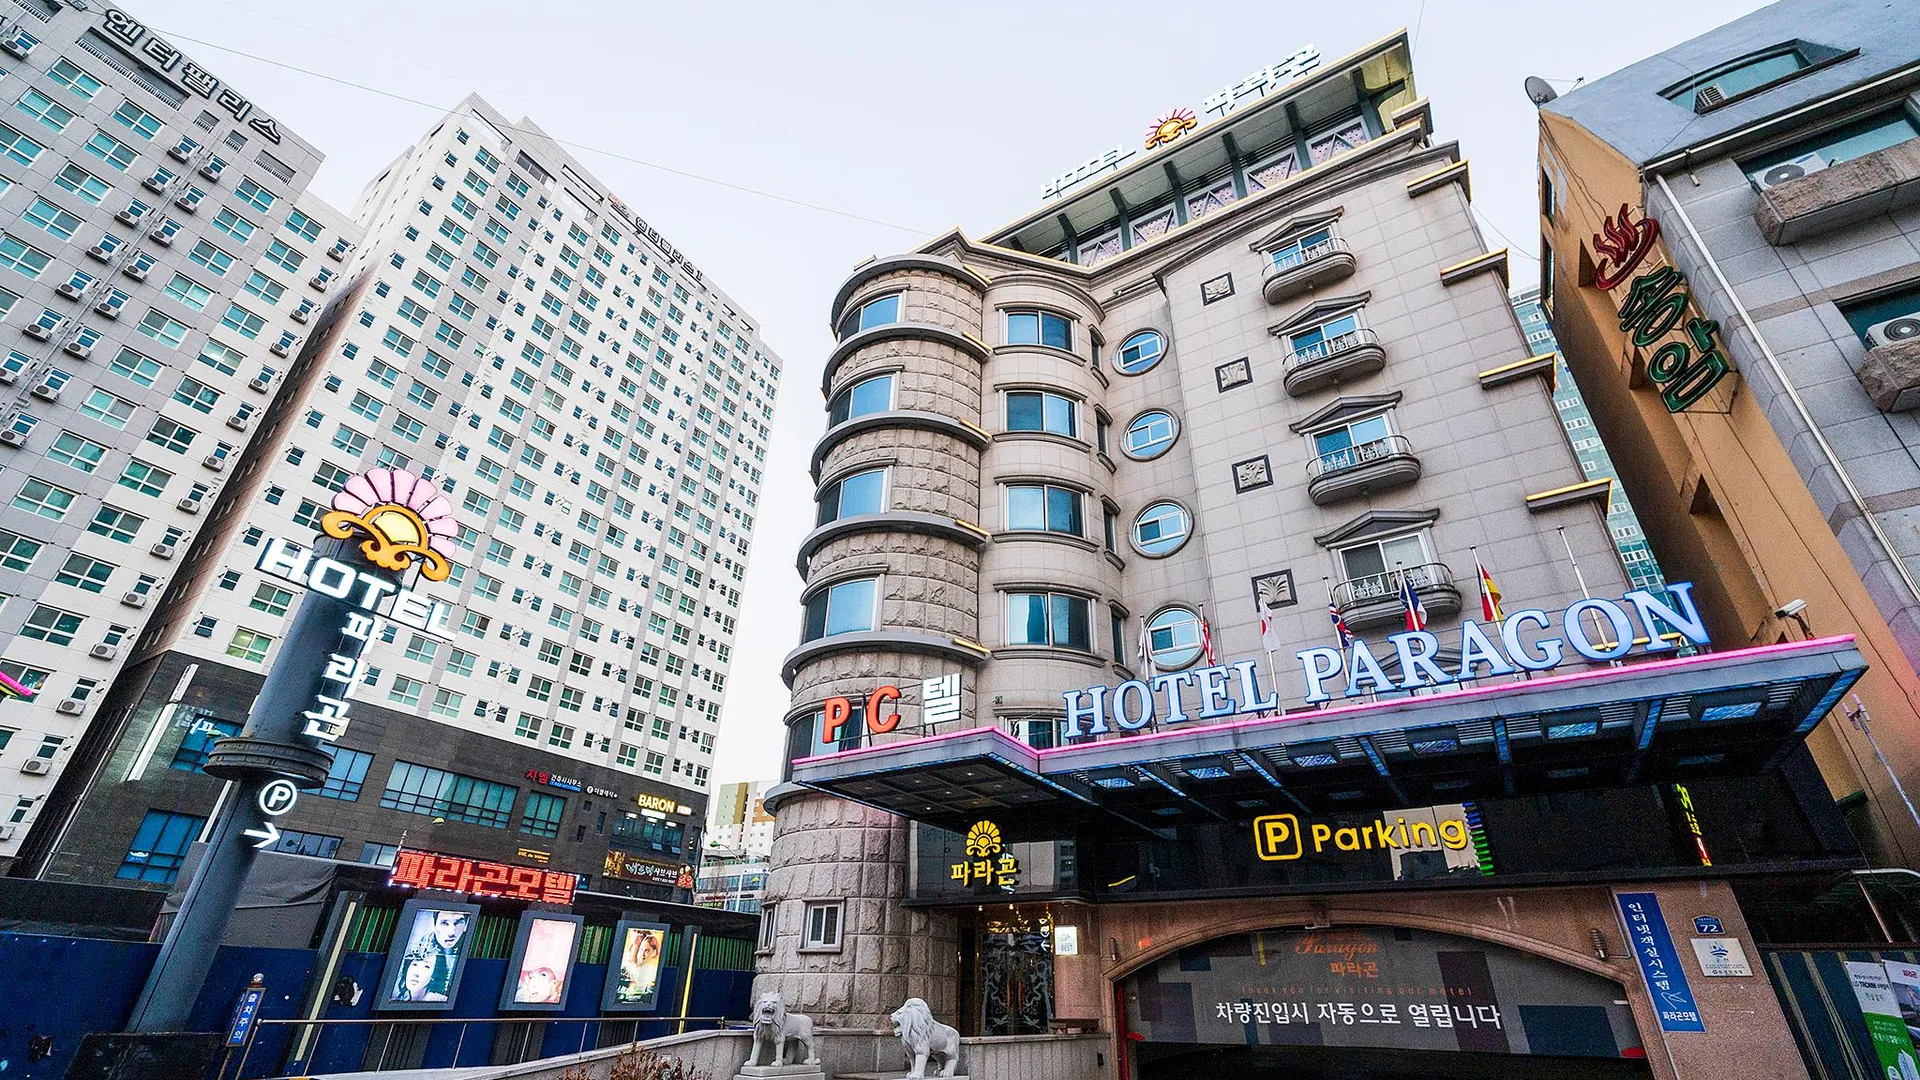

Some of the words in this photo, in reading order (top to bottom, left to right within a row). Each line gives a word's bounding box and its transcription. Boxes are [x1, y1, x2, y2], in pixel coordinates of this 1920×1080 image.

[1203, 43, 1321, 113] 파라곤
[1040, 143, 1136, 199] HOTEL
[256, 537, 457, 641] HOTEL
[301, 612, 386, 741] 파라곤
[1062, 659, 1279, 739] HOTEL
[1296, 581, 1711, 704] PARAGON
[638, 793, 676, 813] BARON
[1310, 816, 1469, 853] Parking
[393, 851, 575, 904] 파라곤모텔
[950, 859, 1017, 887] 파라곤
[1700, 924, 1719, 932] 72
[1330, 961, 1379, 978] 파라곤
[1216, 1002, 1309, 1025] 차량진입시
[1317, 1002, 1401, 1025] 자동으로
[1408, 1002, 1501, 1030] 열립니다
